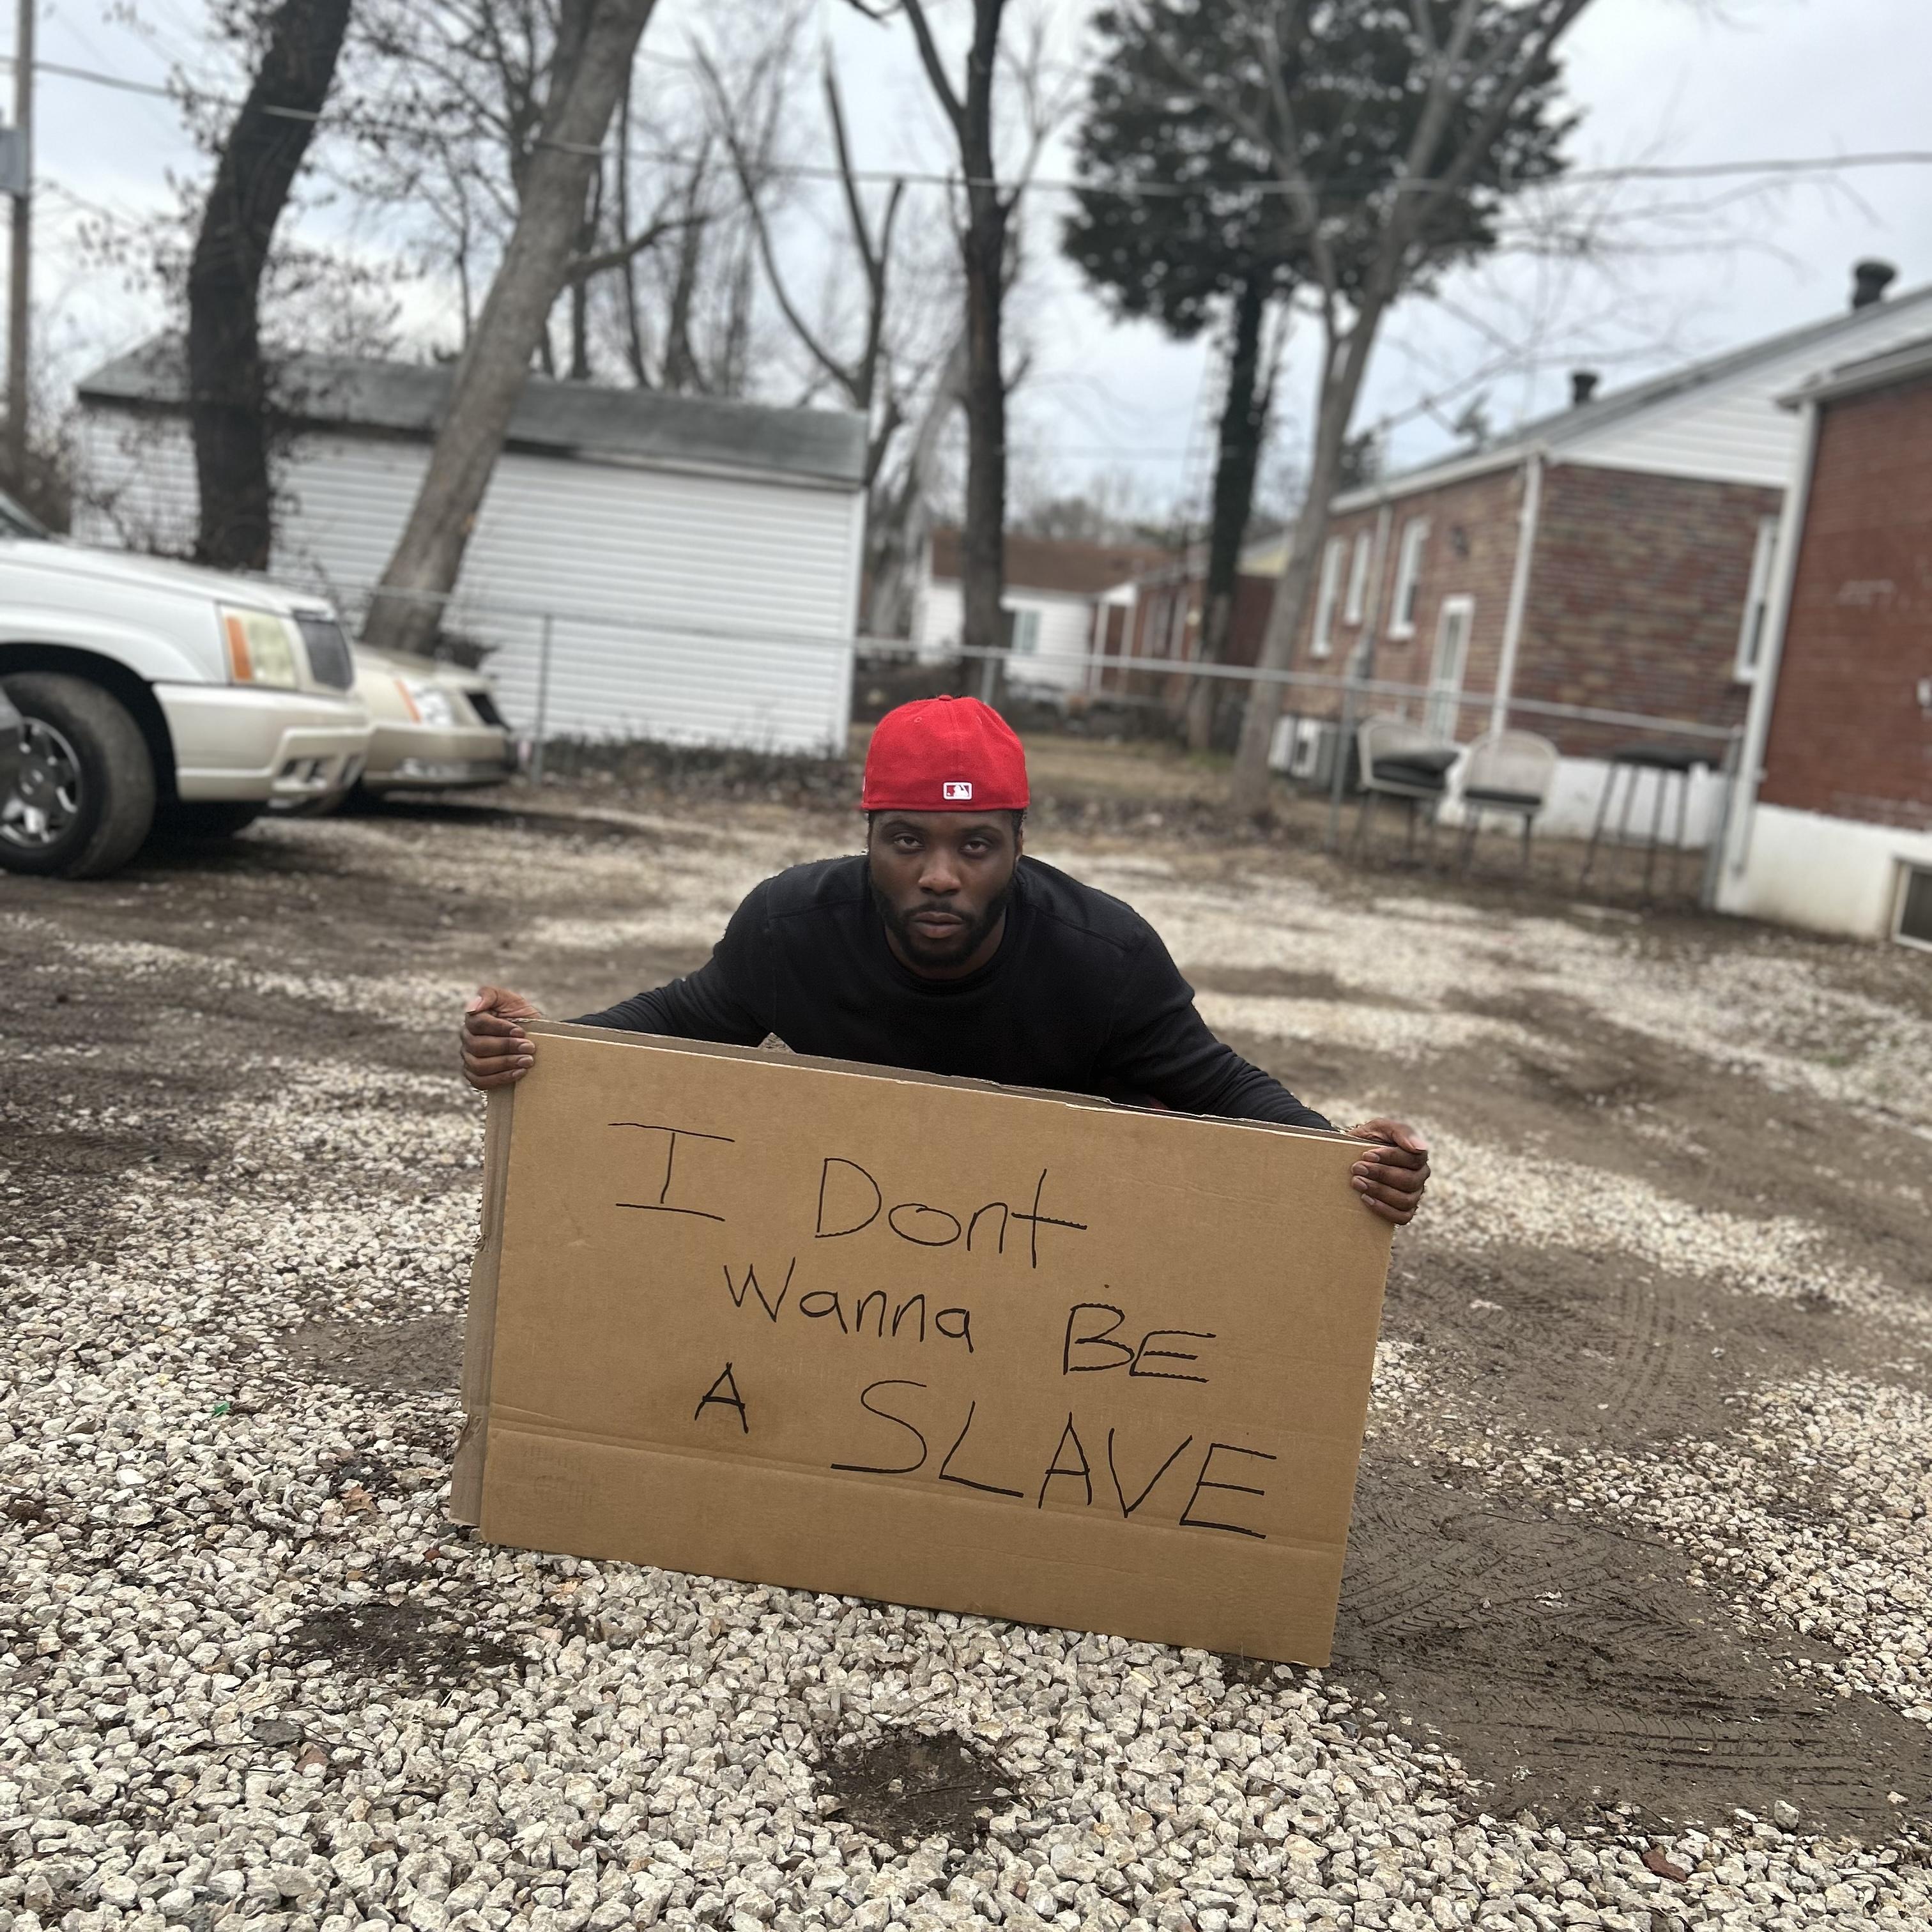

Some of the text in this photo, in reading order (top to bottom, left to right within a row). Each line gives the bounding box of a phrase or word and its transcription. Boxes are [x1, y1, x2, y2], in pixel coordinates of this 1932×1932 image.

[608, 1123, 1088, 1269] I Dont
[724, 1257, 1217, 1383] Wanna BE
[694, 1361, 1277, 1540] A SLAVE
